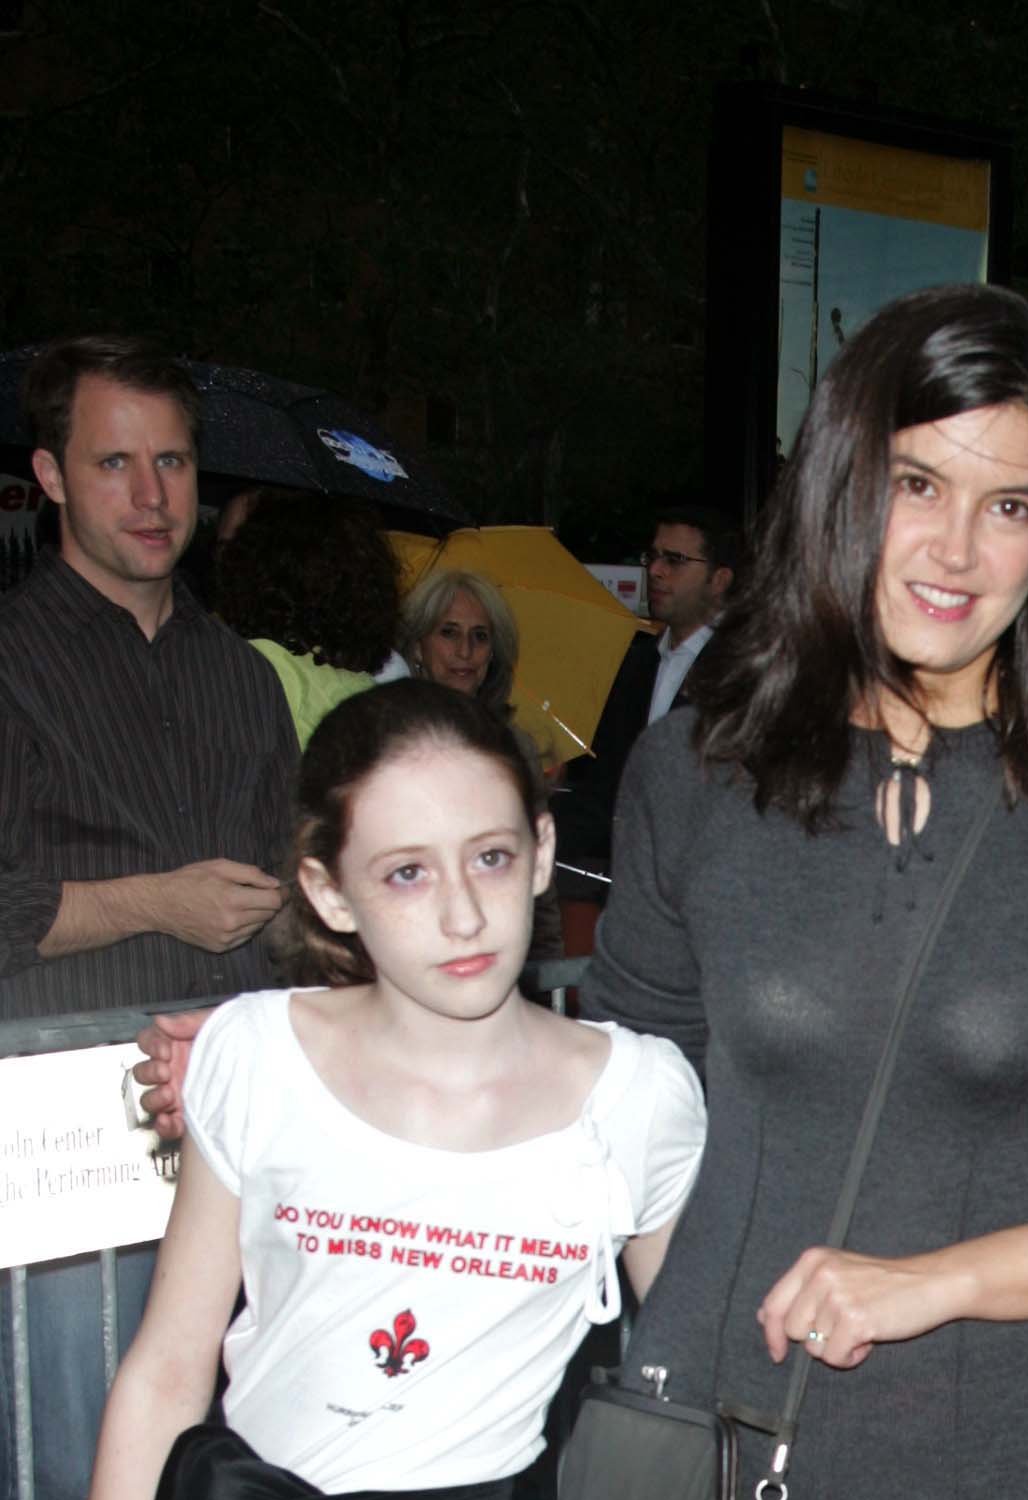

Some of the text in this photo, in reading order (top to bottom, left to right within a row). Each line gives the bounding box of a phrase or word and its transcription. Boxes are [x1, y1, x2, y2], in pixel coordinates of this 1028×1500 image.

[274, 1202, 589, 1261] DO YOU KNOW WHAT IT MEANS
[297, 1232, 558, 1284] TO MISS NEW ORLEANS
